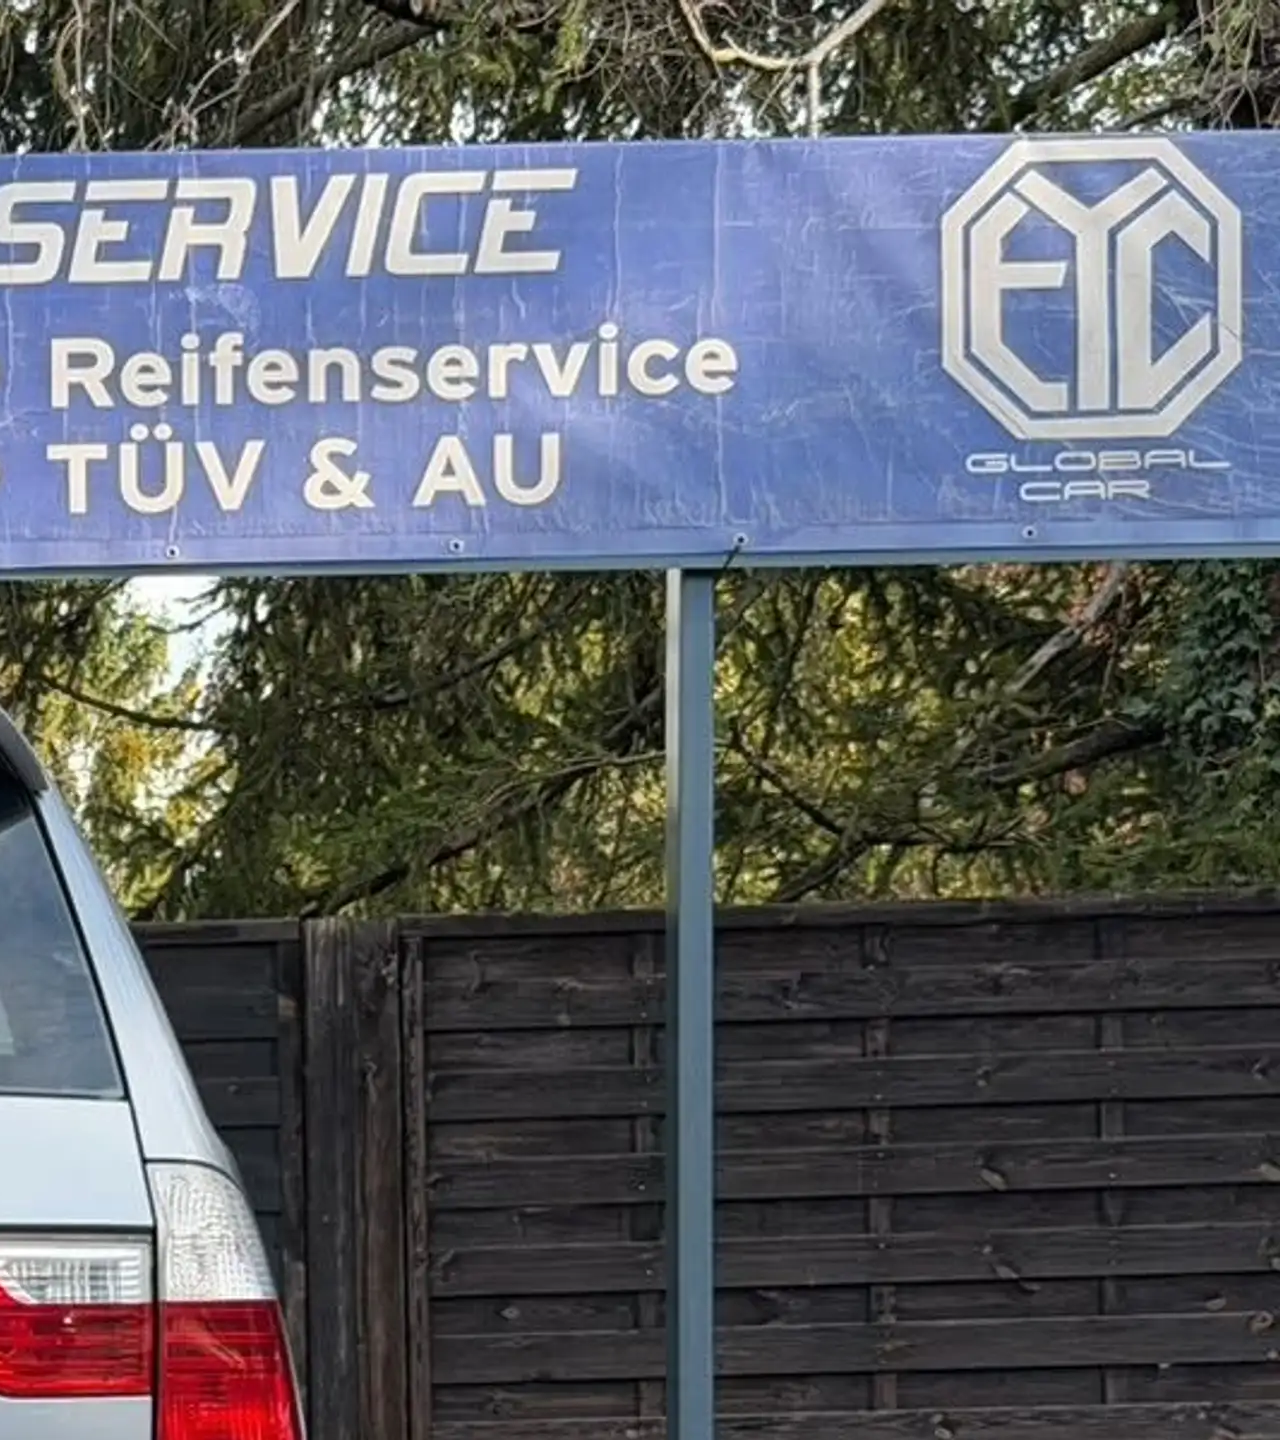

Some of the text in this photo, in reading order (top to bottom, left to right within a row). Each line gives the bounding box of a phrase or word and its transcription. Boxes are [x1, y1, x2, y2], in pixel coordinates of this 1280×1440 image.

[51, 320, 739, 421] Reifenservice
[46, 422, 561, 515] TÜV & AU
[965, 449, 1232, 474] GLOBAL
[1019, 479, 1151, 502] CAR
